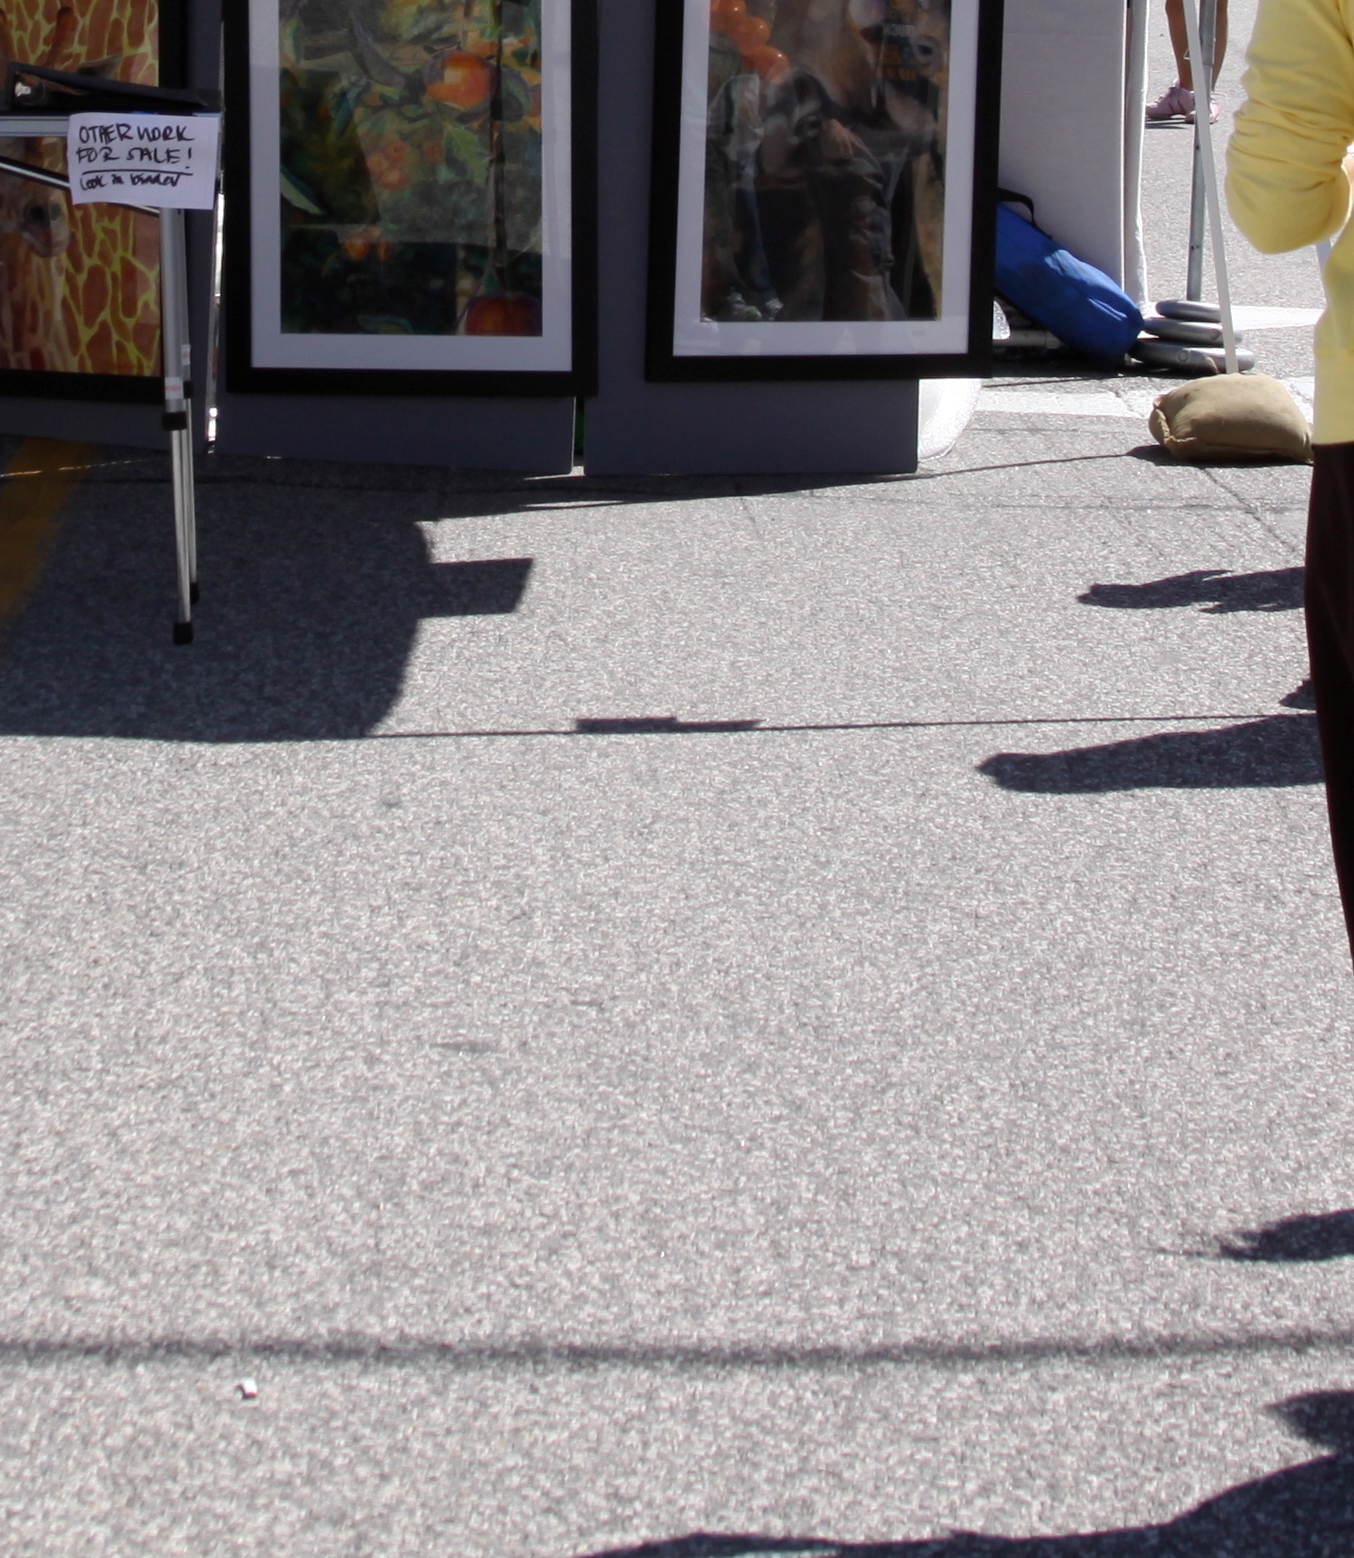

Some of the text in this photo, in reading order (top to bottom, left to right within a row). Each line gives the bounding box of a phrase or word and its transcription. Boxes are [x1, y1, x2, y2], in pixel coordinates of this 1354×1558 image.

[79, 123, 195, 145] OTHER WORK
[76, 146, 193, 169] FOR SALE!
